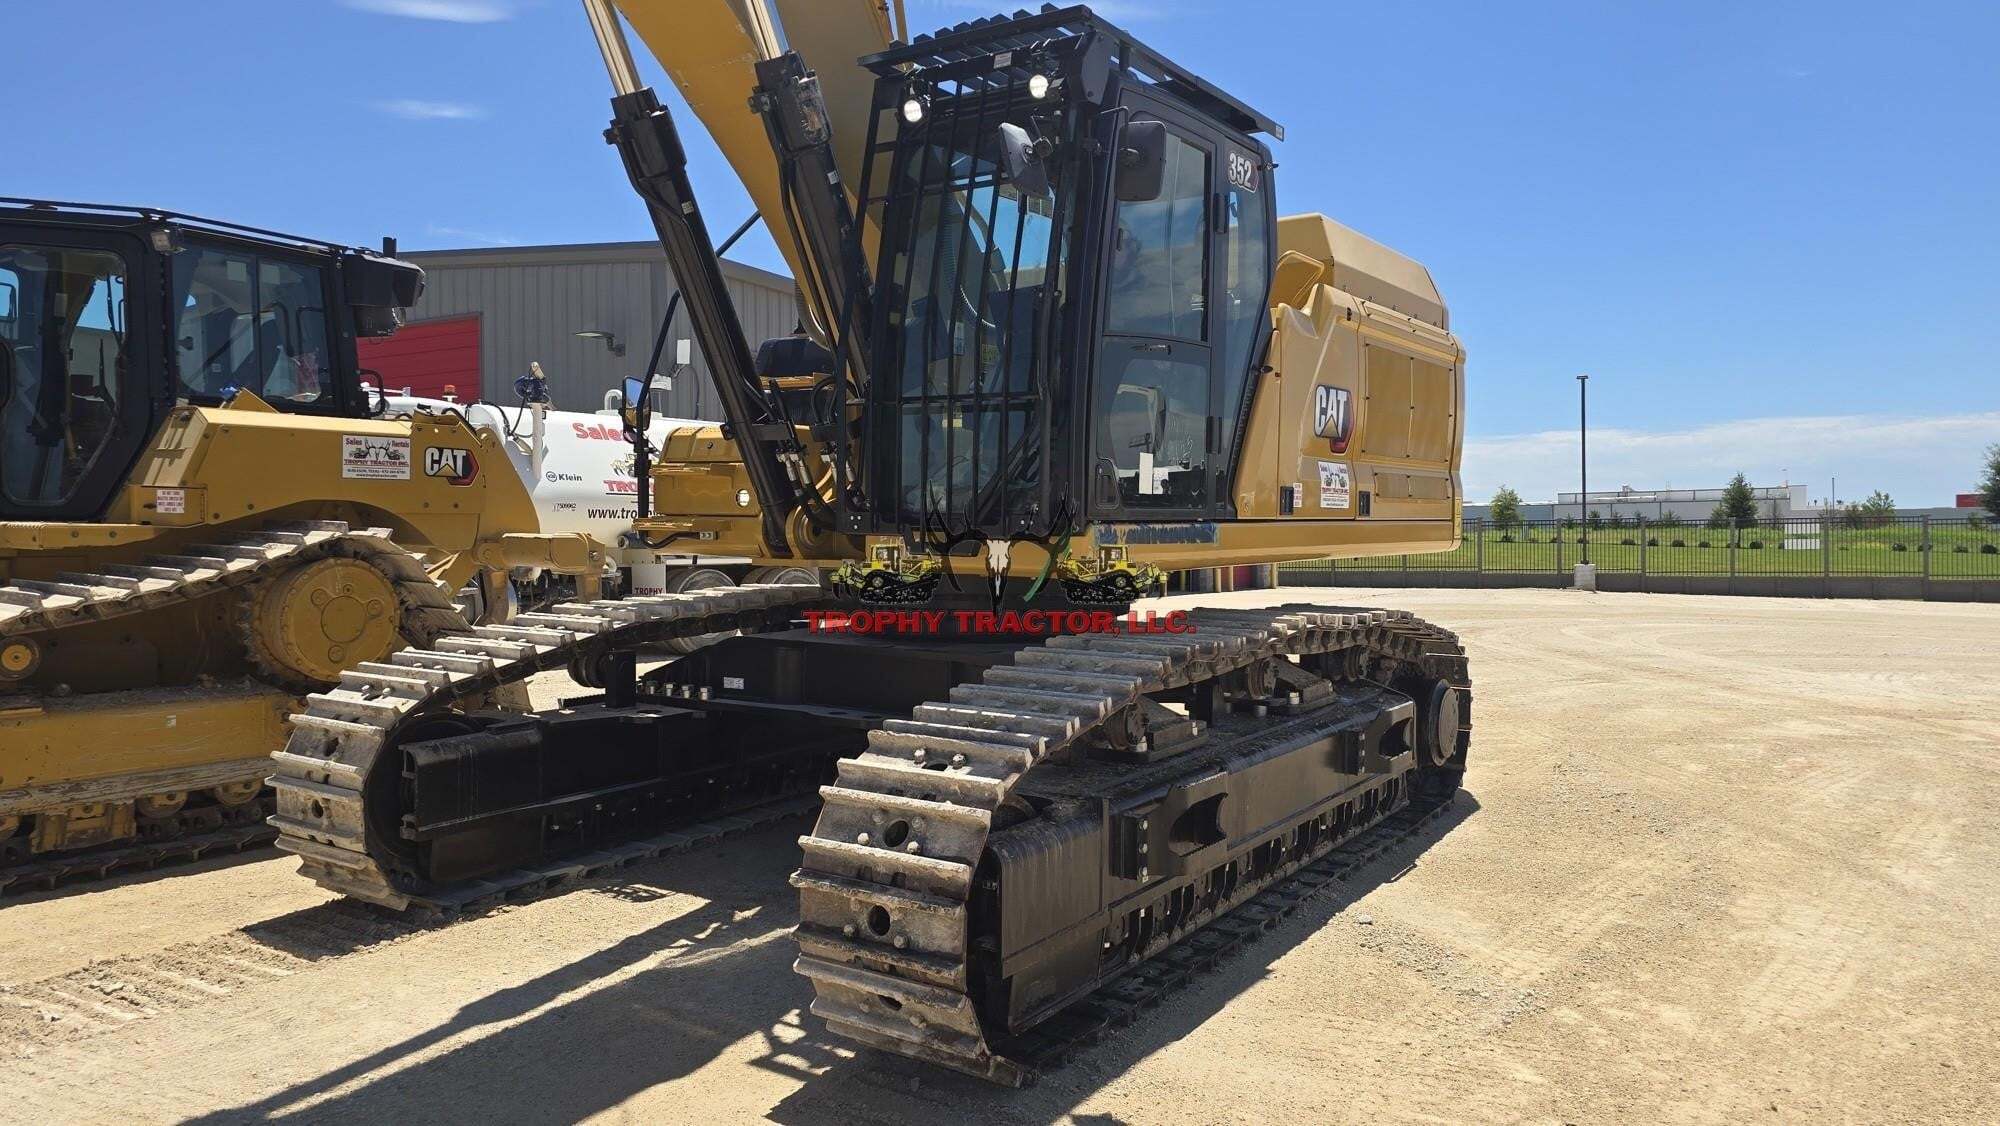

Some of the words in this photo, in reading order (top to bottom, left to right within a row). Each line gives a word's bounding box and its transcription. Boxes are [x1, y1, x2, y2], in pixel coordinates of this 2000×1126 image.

[1229, 152, 1255, 189] 352
[1315, 385, 1348, 437] CAT
[425, 447, 467, 477] CAT
[558, 473, 583, 482] Klein
[634, 587, 663, 596] TROPHY
